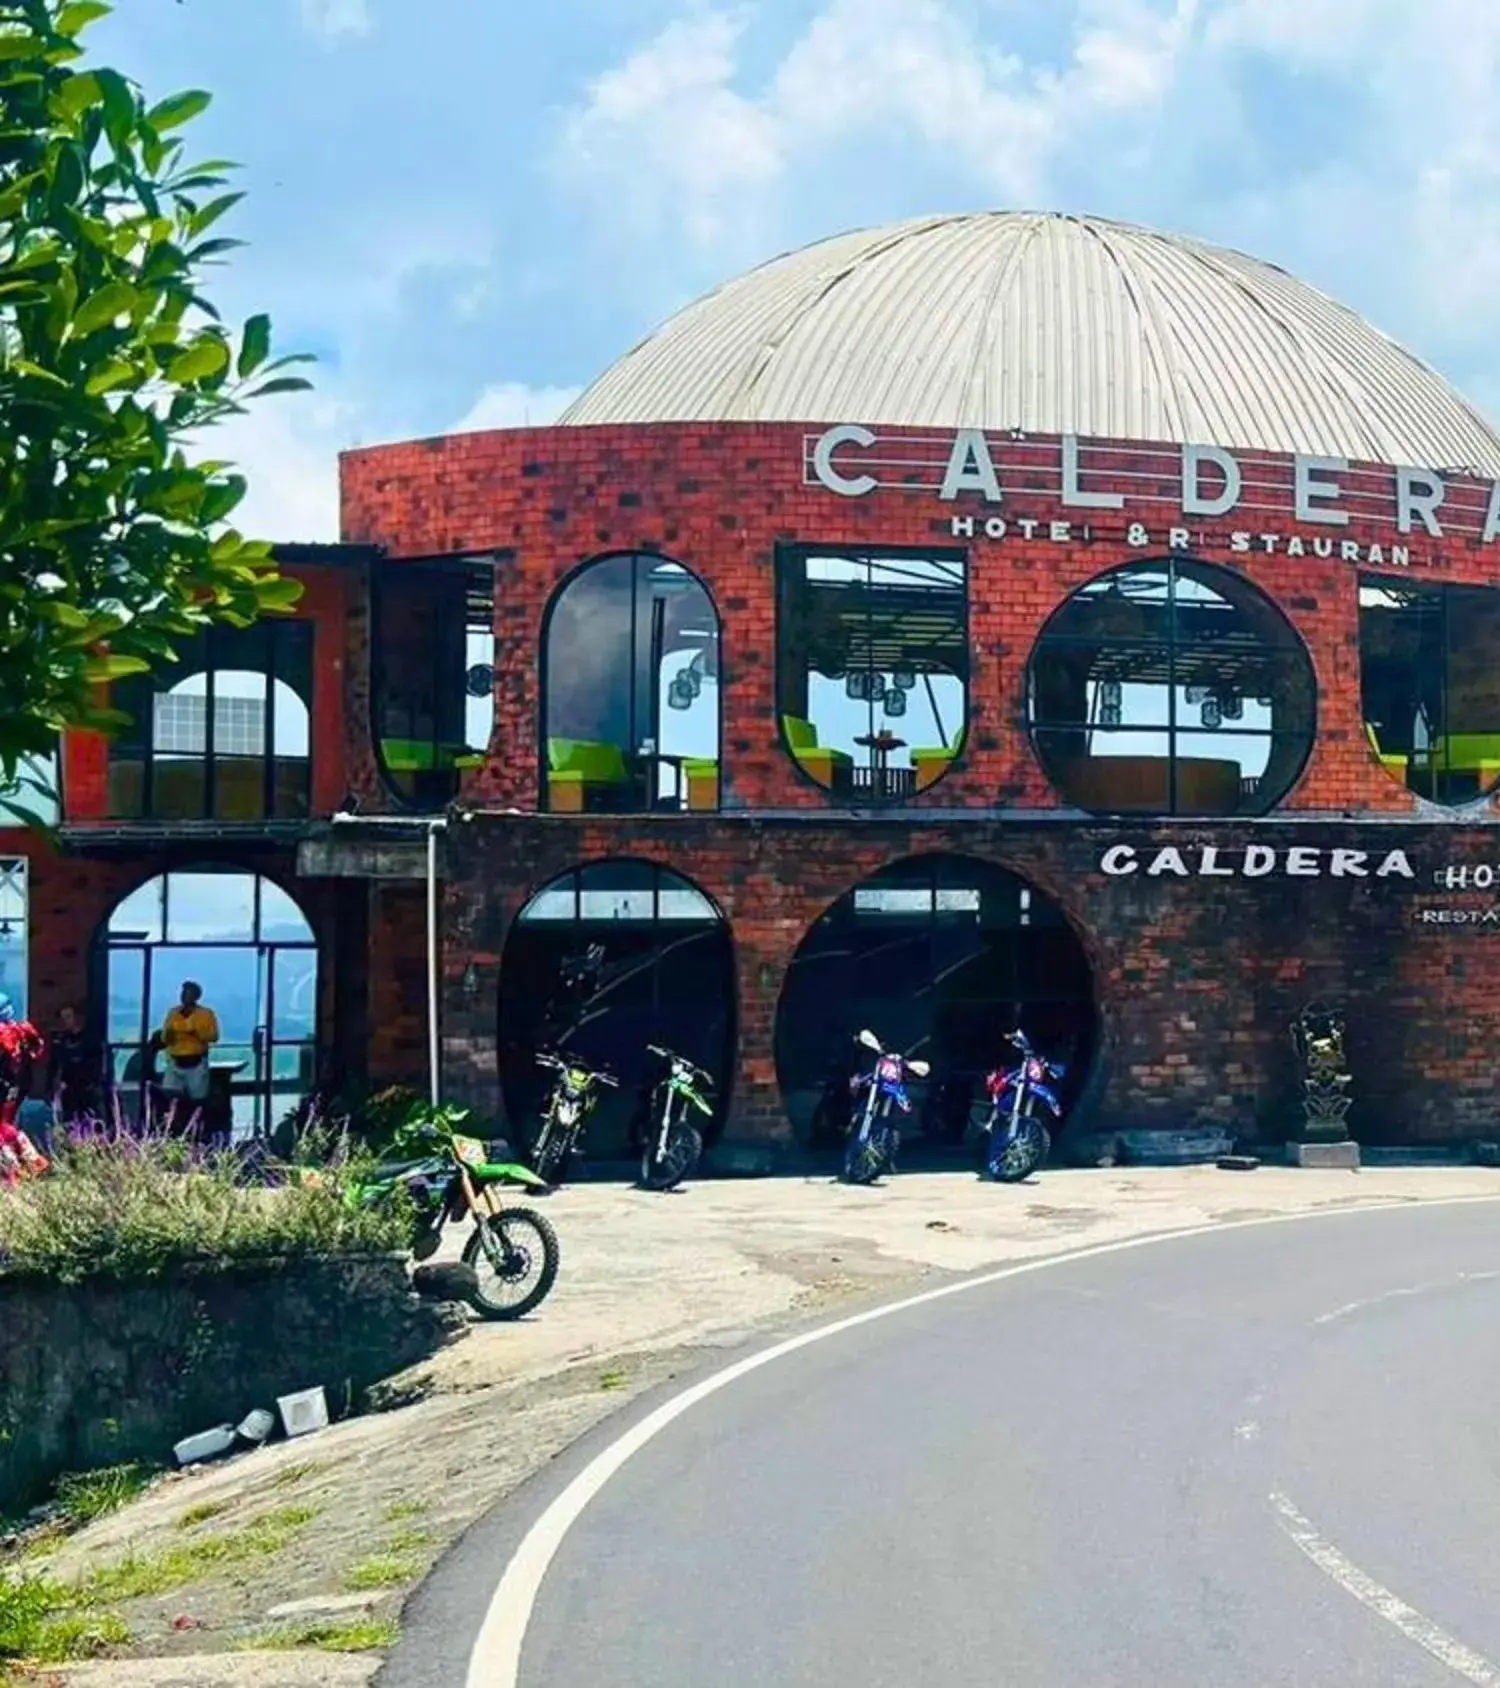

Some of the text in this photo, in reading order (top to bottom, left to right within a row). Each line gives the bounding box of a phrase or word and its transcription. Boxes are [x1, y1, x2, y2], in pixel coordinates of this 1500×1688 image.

[1127, 522, 1149, 546] &
[1169, 527, 1432, 567] RSTAURAN
[1100, 844, 1415, 878] CALDERA
